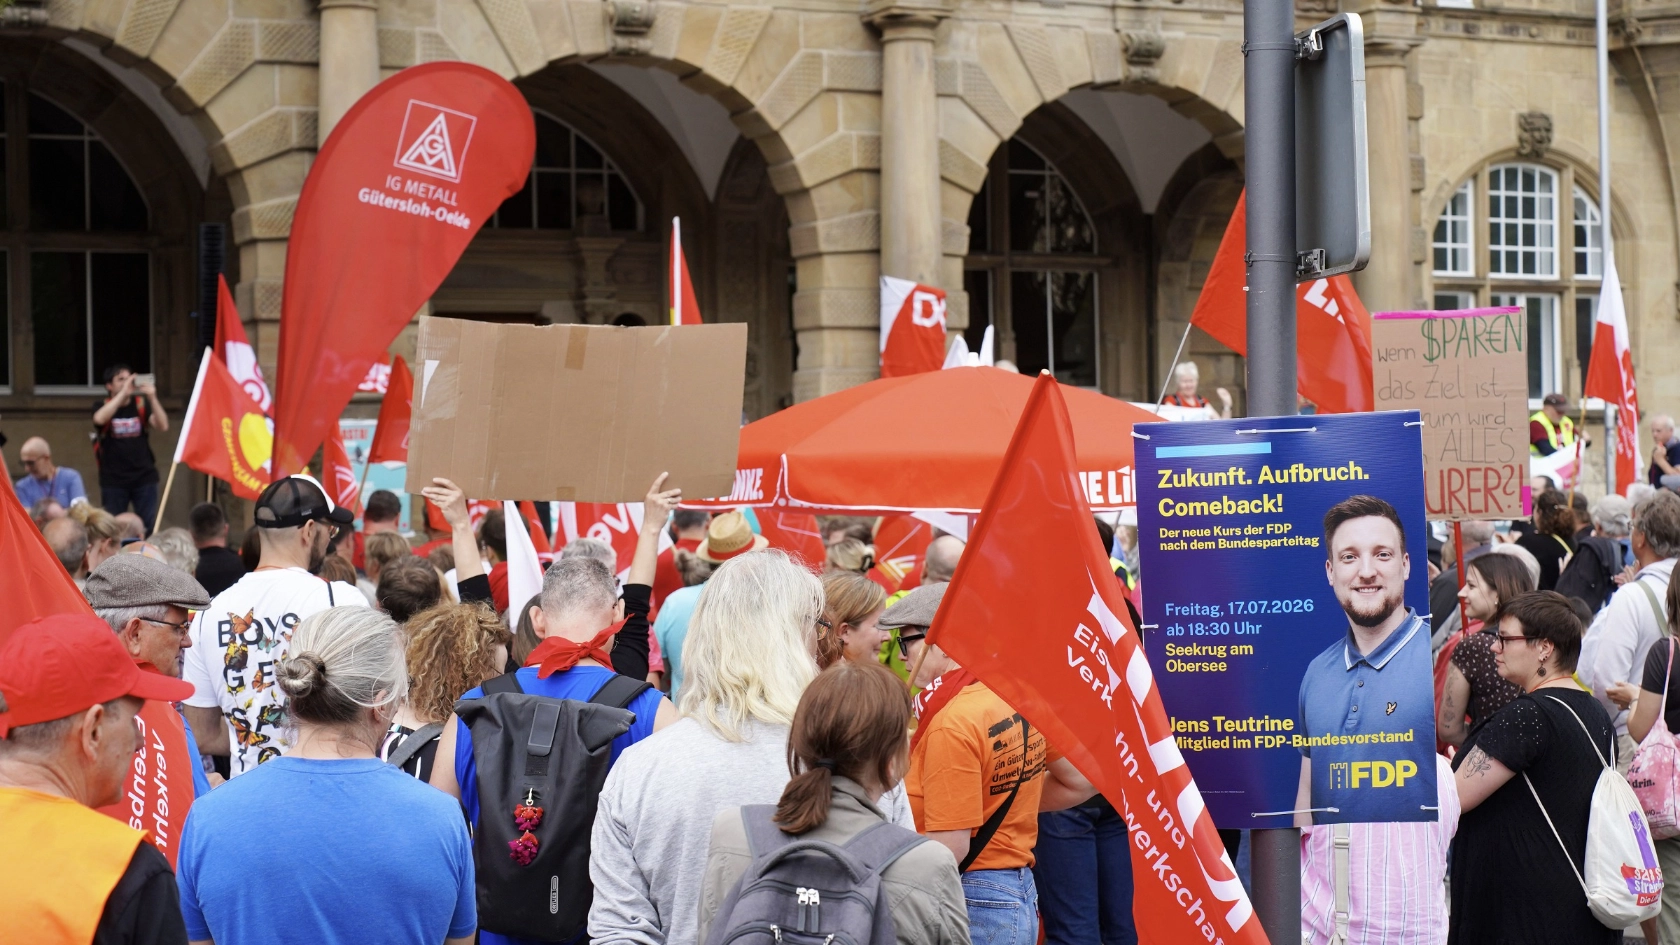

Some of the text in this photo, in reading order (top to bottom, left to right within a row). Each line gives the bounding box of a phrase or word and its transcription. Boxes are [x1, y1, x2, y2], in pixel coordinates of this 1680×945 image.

[385, 174, 458, 206] IG METALL
[1378, 346, 1416, 363] wenn
[1378, 364, 1508, 401] das Ziel ist,
[1421, 402, 1506, 429] rum wird
[1440, 427, 1515, 464] ALLES
[1157, 460, 1370, 489] Zukunft. Aufbruch.
[1424, 463, 1525, 515] URER?!
[1157, 493, 1284, 517] Comeback!
[1159, 523, 1292, 539] Der neue Kurs der FDP
[1159, 536, 1320, 551] nach dem Bundesparteitag
[1165, 599, 1315, 618] Freitag, 17.07.2026
[1166, 621, 1262, 637] ab 18:30 Uhr
[1165, 643, 1254, 658] Seekrug am
[1165, 659, 1227, 673] Obersee
[1212, 715, 1294, 732] Teutrine
[1232, 736, 1252, 749] im
[1254, 729, 1414, 749] FDP-Bundesvorstand
[1008, 752, 1025, 766] Güter
[1351, 760, 1418, 789] FDP
[1632, 777, 1656, 789] drin.
